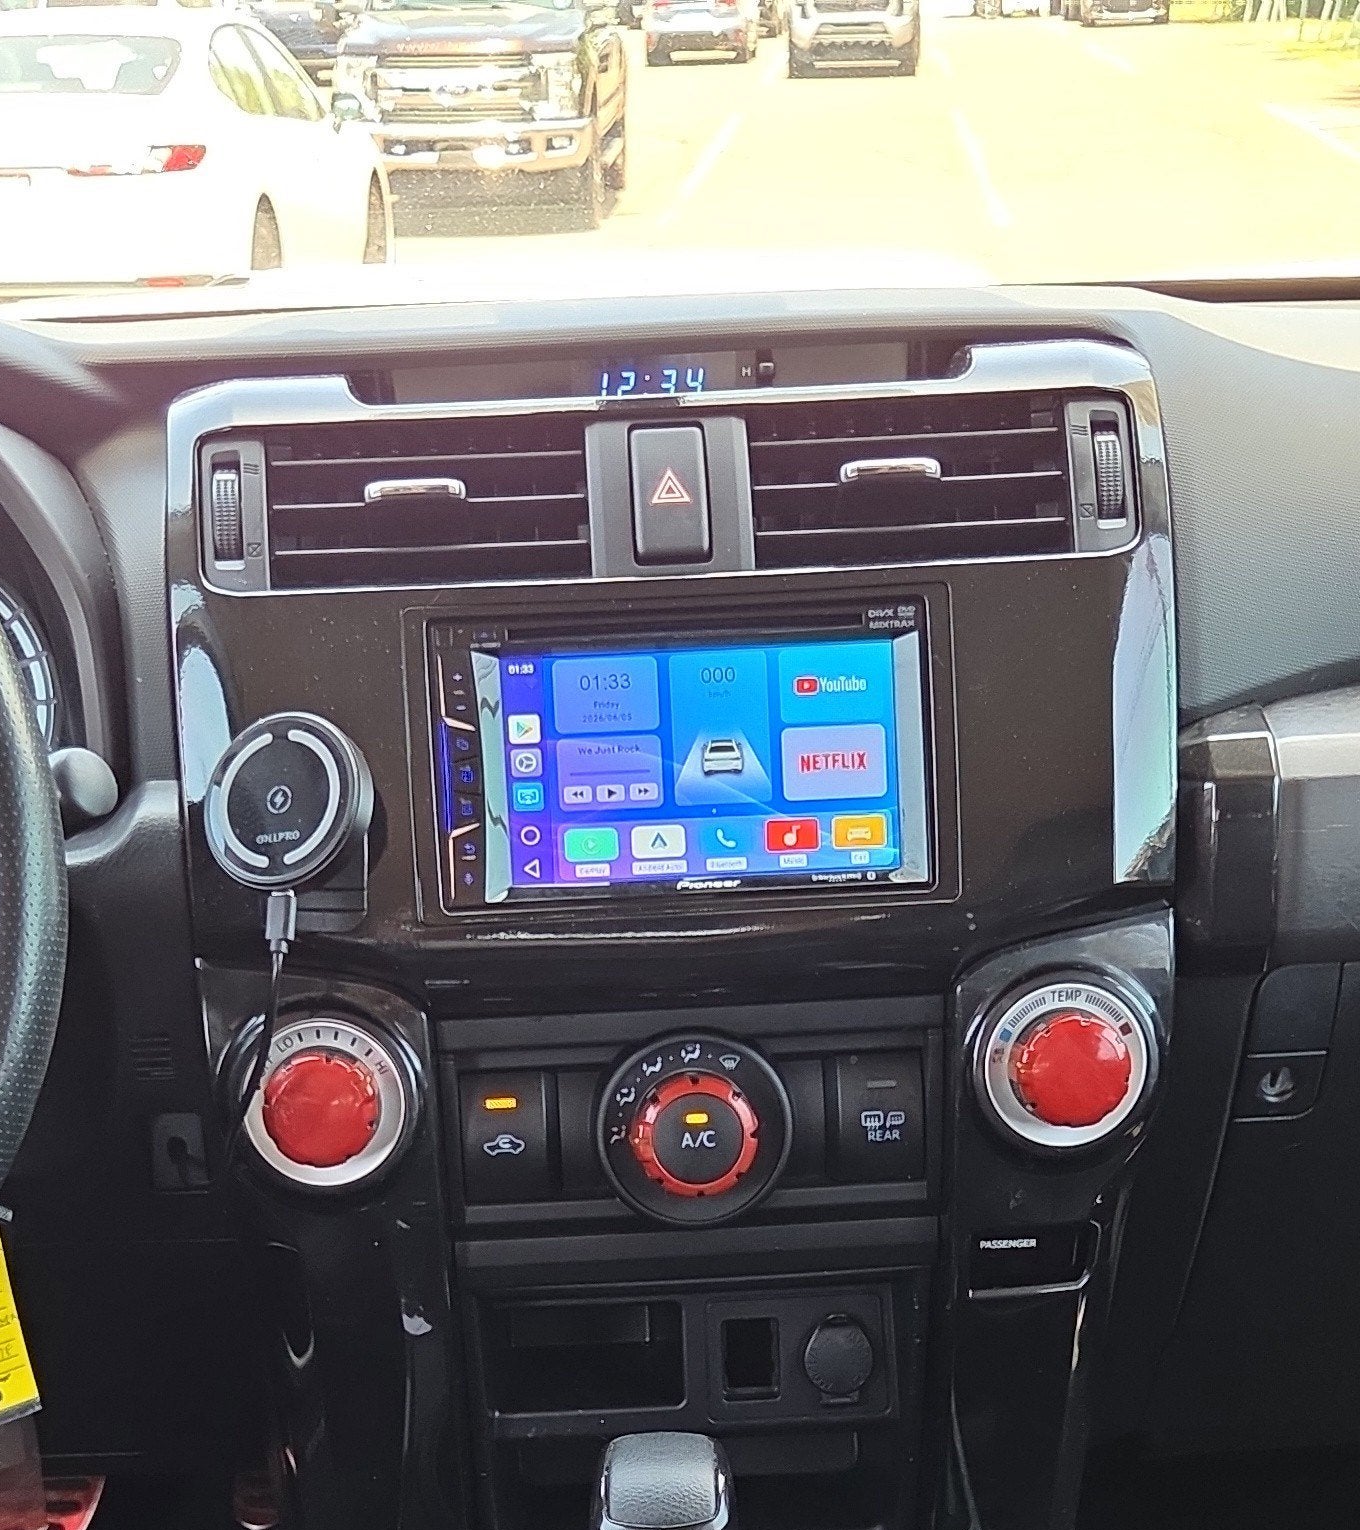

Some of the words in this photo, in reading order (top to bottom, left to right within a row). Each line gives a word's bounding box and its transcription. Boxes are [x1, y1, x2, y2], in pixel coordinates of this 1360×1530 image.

[507, 664, 535, 675] 01:33
[700, 667, 736, 684] 000
[579, 673, 632, 691] 01:33
[818, 676, 867, 693] YouTube
[799, 752, 868, 773] NETFLIX
[1050, 989, 1082, 1003] TEMP
[276, 1036, 295, 1054] LO
[374, 1060, 391, 1076] HI
[681, 1130, 717, 1149] A/C
[867, 1128, 902, 1142] REAR
[979, 1239, 1037, 1249] PASSENGER
